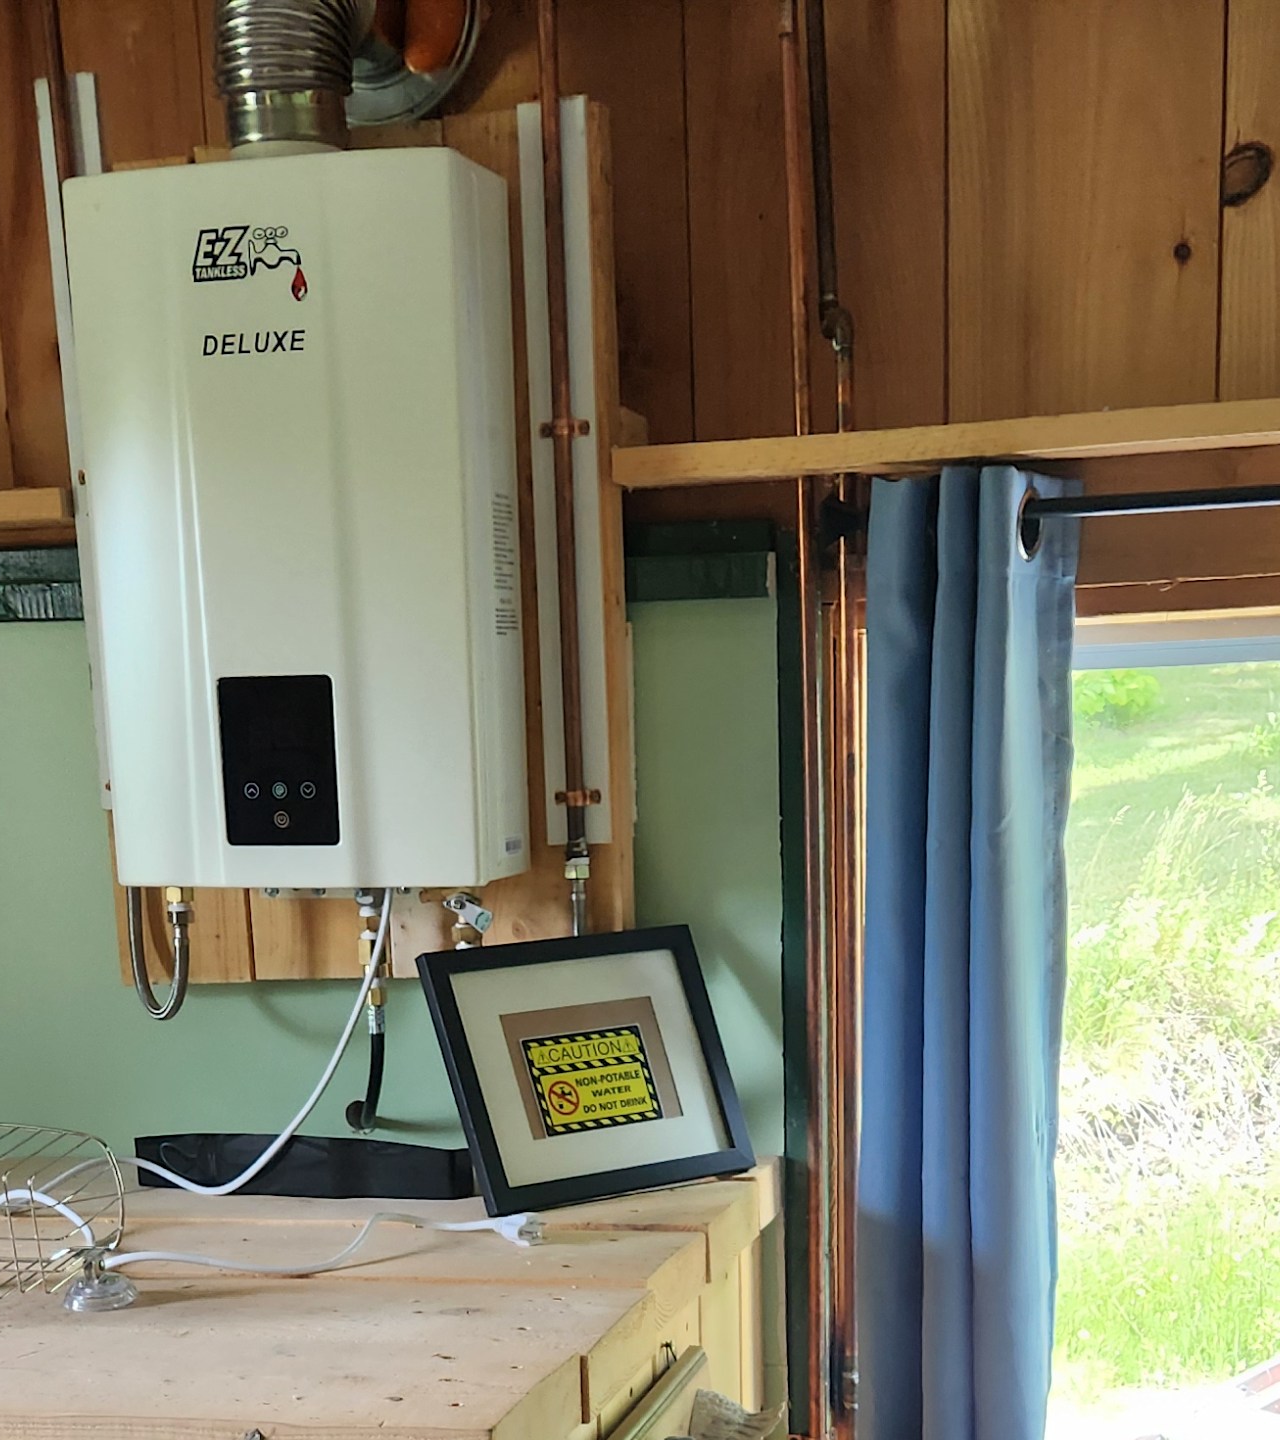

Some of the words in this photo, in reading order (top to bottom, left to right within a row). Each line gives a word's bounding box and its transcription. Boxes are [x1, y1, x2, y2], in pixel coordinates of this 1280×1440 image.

[194, 264, 246, 280] TANKLESS
[203, 330, 306, 356] DELUXE
[548, 1039, 622, 1062] CAUTION
[575, 1069, 641, 1087] NON-POTABLE
[591, 1085, 631, 1098] WATER
[583, 1104, 597, 1114] DO
[599, 1100, 618, 1111] NOT
[620, 1096, 648, 1108] DRINK
